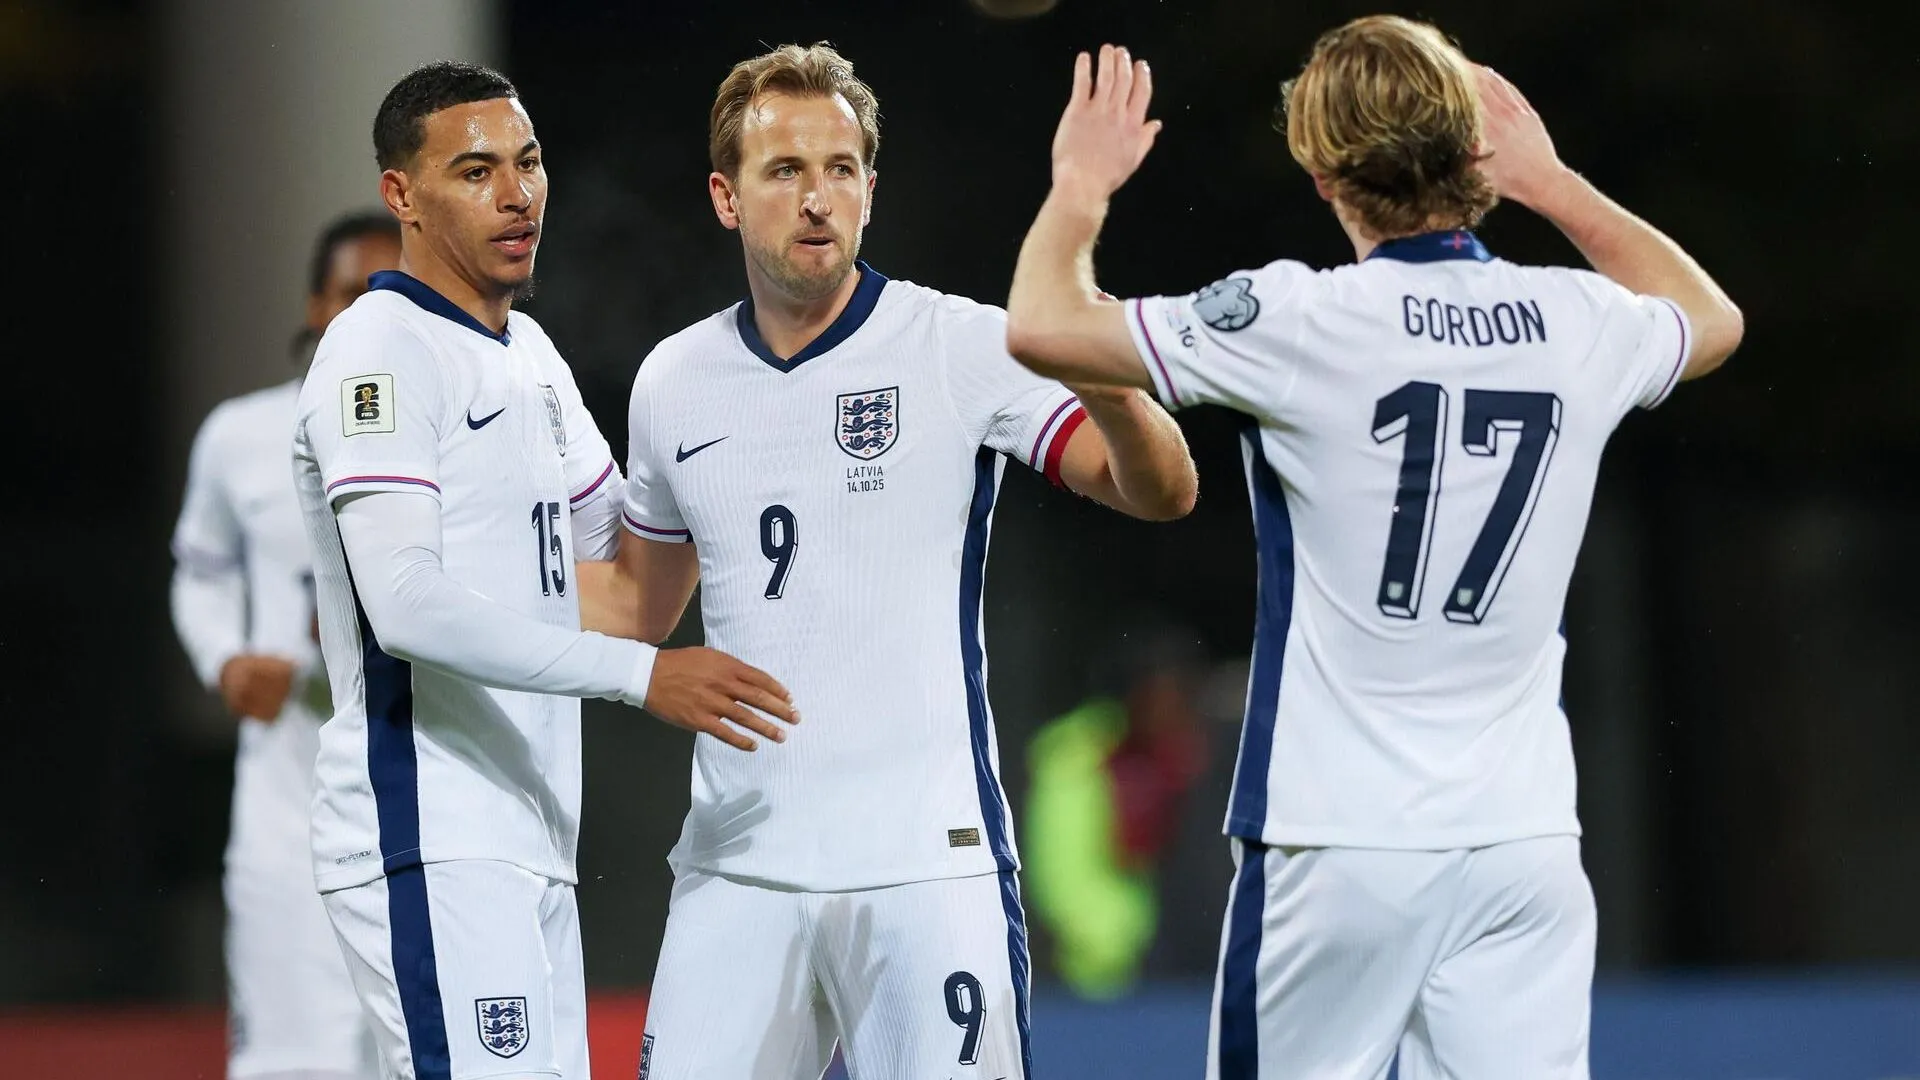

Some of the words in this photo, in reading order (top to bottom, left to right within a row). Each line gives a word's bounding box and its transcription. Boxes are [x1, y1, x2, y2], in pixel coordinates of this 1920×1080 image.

[1402, 294, 1546, 347] GORDON
[846, 466, 884, 479] LATVIA
[847, 478, 884, 493] 14.10.25
[1371, 380, 1563, 625] 17
[531, 501, 566, 597] 15
[760, 504, 799, 600] 9
[943, 970, 987, 1066] 9
